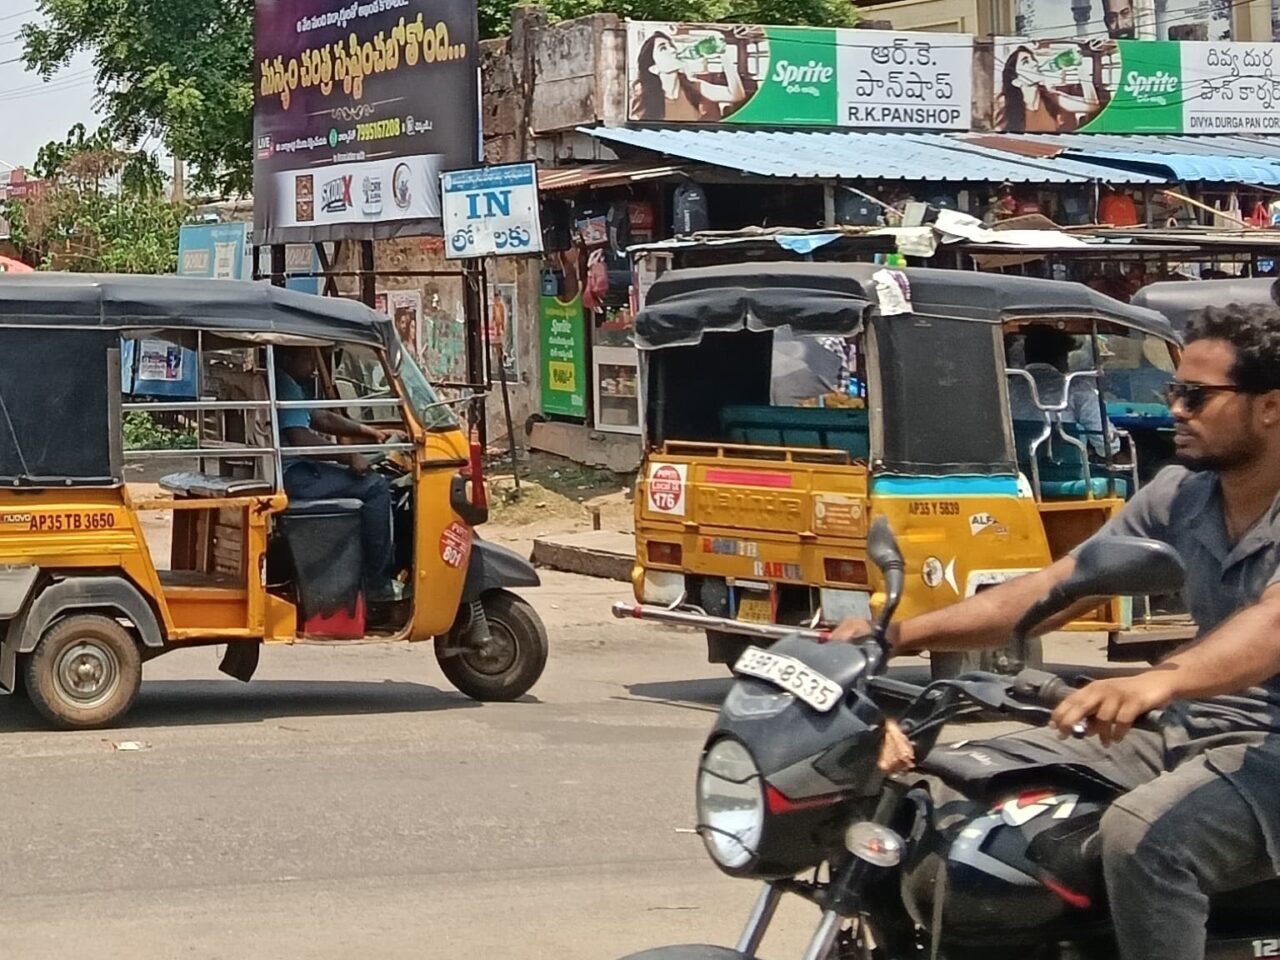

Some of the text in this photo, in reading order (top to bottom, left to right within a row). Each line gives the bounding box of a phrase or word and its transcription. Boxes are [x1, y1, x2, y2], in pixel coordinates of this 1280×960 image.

[772, 60, 833, 87] Sprite
[1207, 48, 1273, 77] దివ్య దుర్గ
[261, 55, 298, 109] మన్యం
[300, 44, 333, 95] చరిత్ర
[1124, 71, 1178, 97] Sprite
[1201, 79, 1233, 101] పాన్
[848, 106, 960, 124] R.K.PANSHOP
[1190, 117, 1213, 128] DIVYA
[1215, 117, 1243, 128] DURGA
[1245, 116, 1261, 128] PAN
[466, 190, 512, 219] IN
[654, 493, 676, 508] 176
[30, 513, 115, 531] AP35 TB 3650
